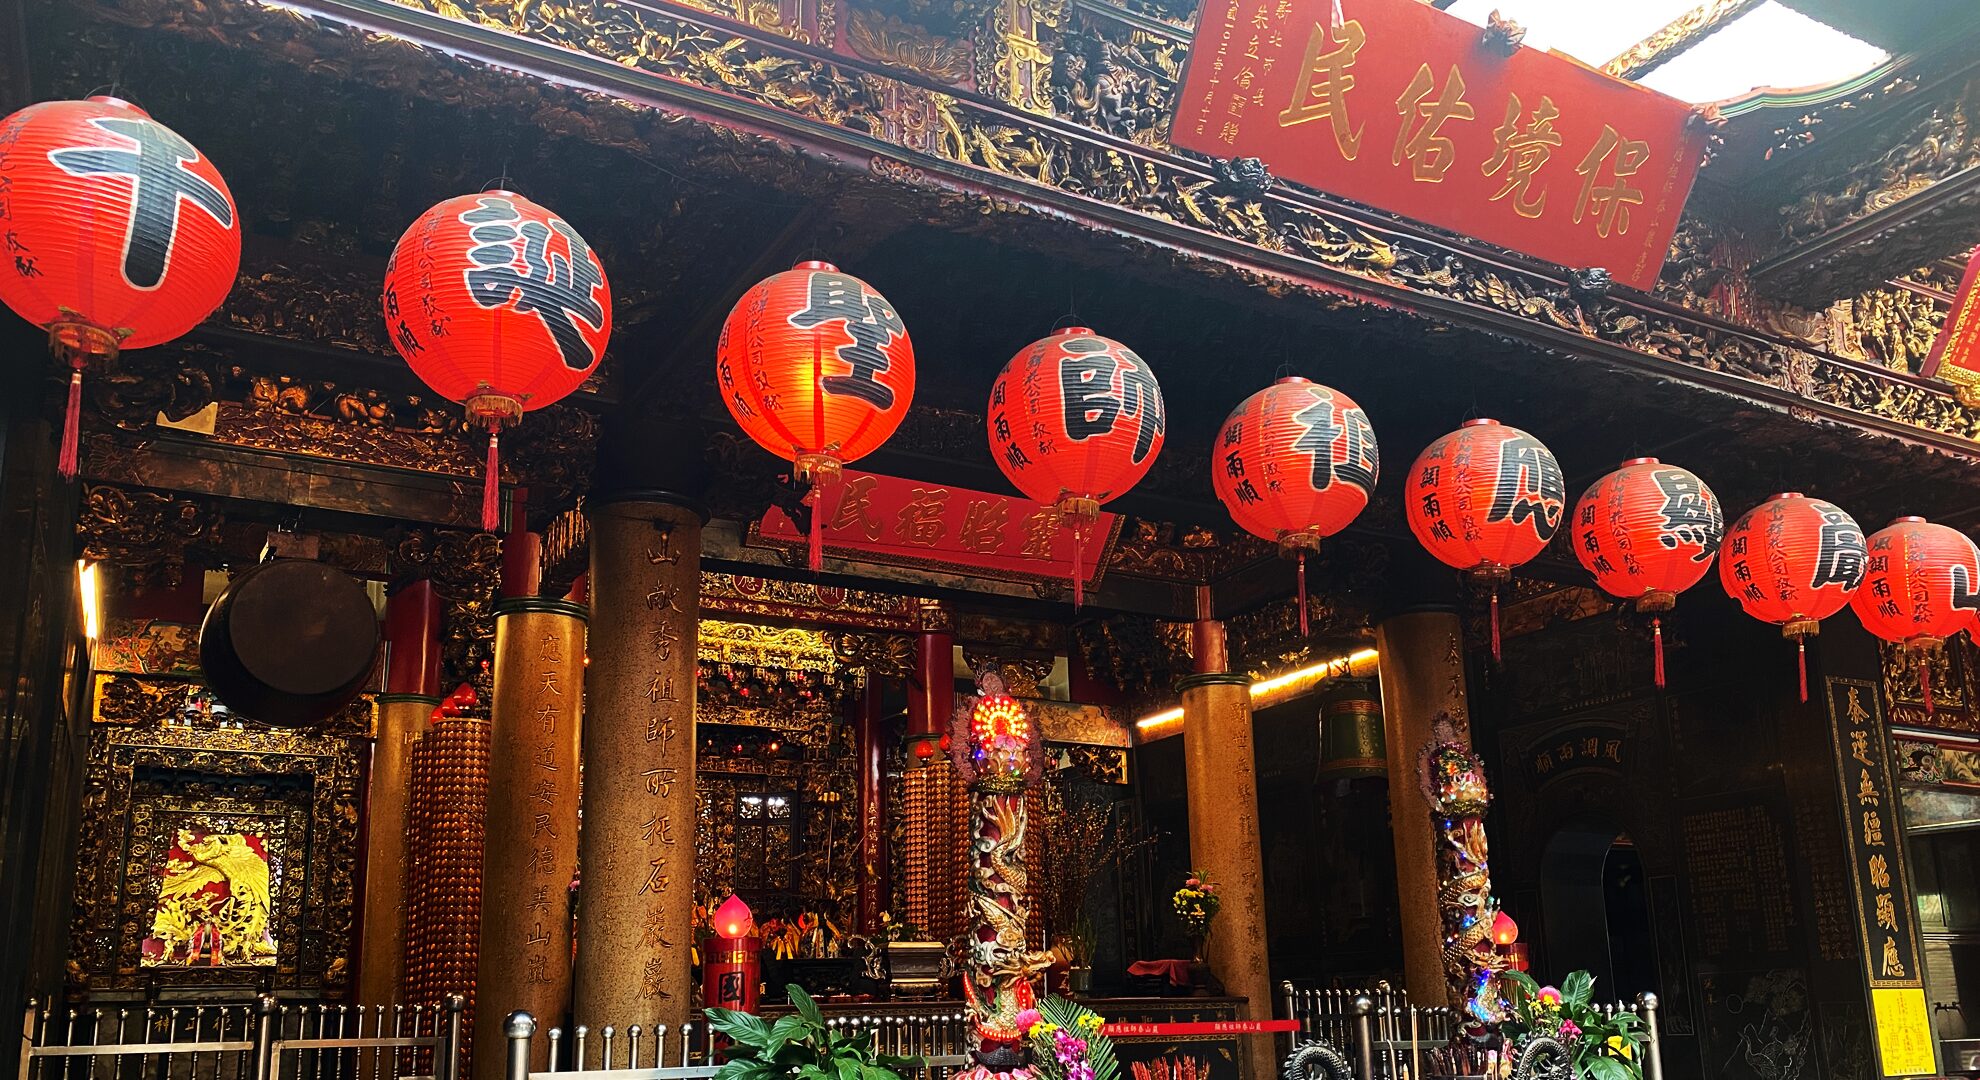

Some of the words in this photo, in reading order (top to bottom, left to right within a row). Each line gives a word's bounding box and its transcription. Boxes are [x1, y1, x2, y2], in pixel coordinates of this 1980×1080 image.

[1279, 19, 1650, 239] 保境佑民
[47, 119, 233, 291] 千
[458, 197, 604, 372] 誕
[787, 271, 906, 414] 聖
[1058, 337, 1166, 465] 師
[1289, 387, 1380, 493] 祖
[1420, 440, 1458, 543] 風調雨順
[1868, 535, 1904, 618] 風調雨順
